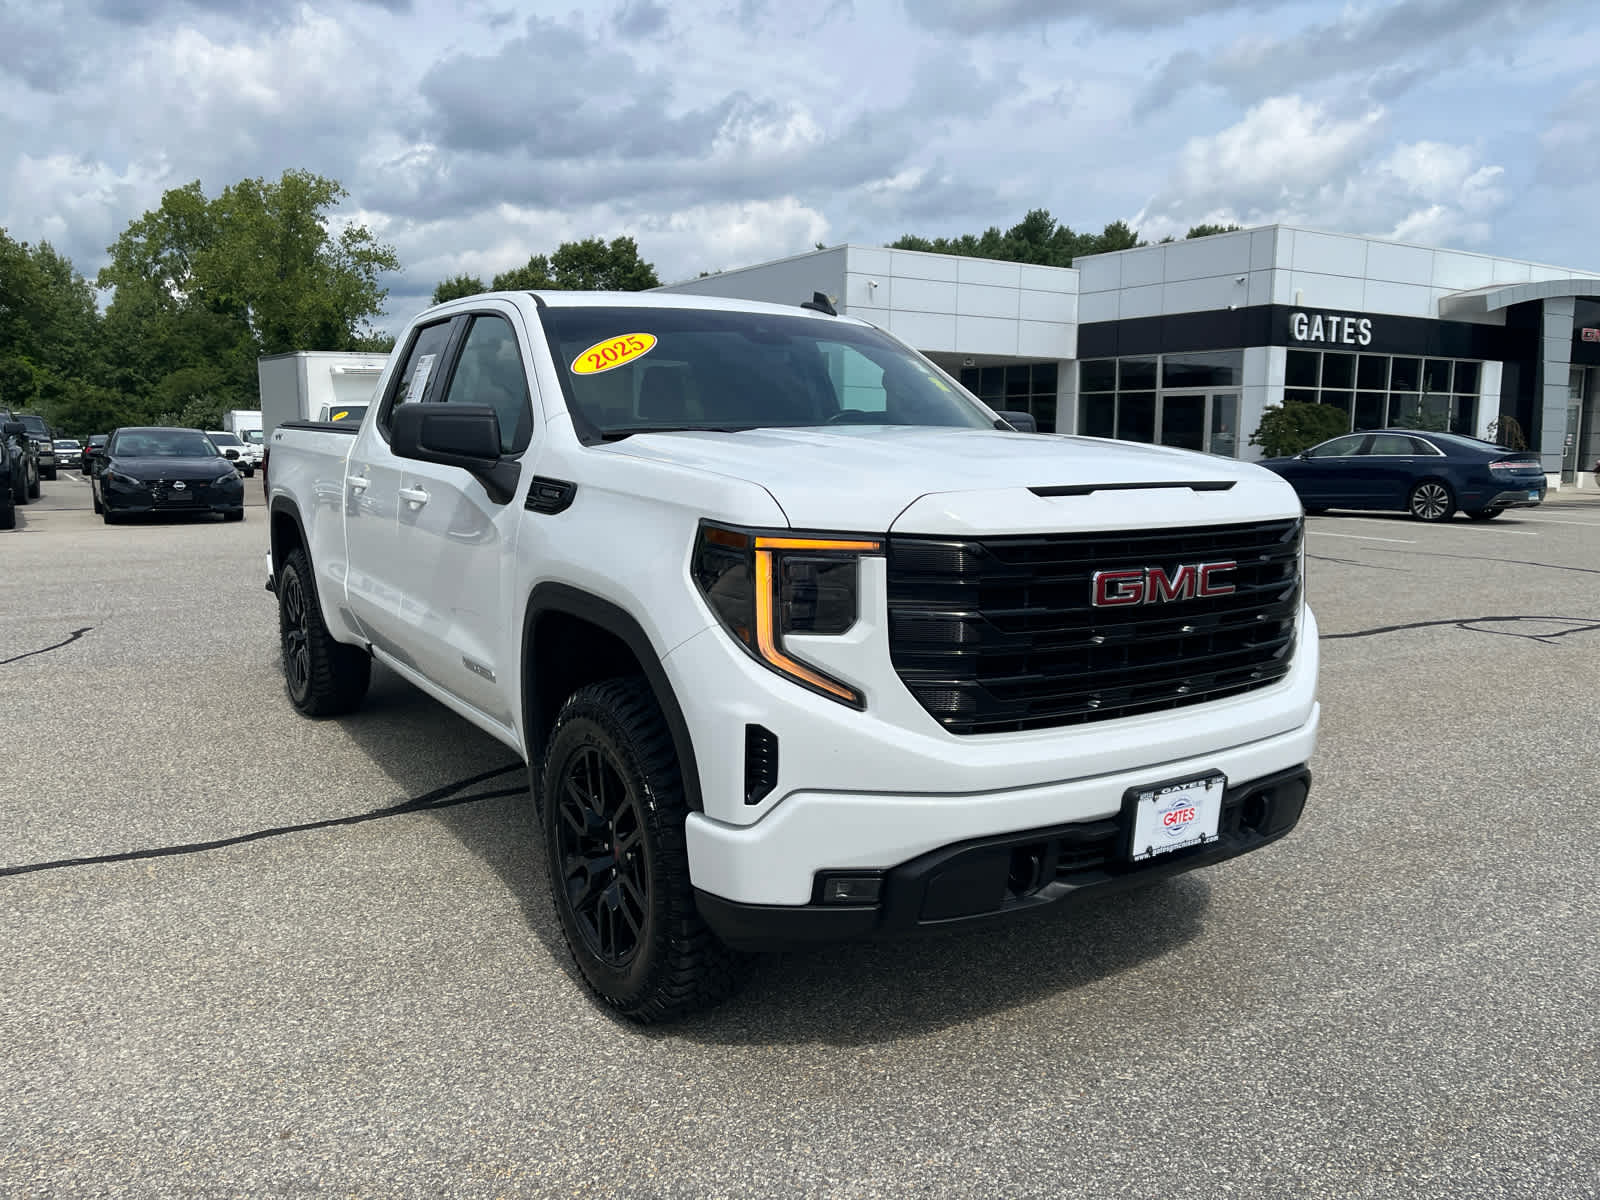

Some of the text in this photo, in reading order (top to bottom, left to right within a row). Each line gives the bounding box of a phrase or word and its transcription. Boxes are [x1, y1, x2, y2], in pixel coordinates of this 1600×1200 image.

[1290, 312, 1372, 346] GATES
[588, 336, 645, 369] 2025
[1092, 561, 1237, 607] GMC
[1163, 807, 1195, 826] GATES
